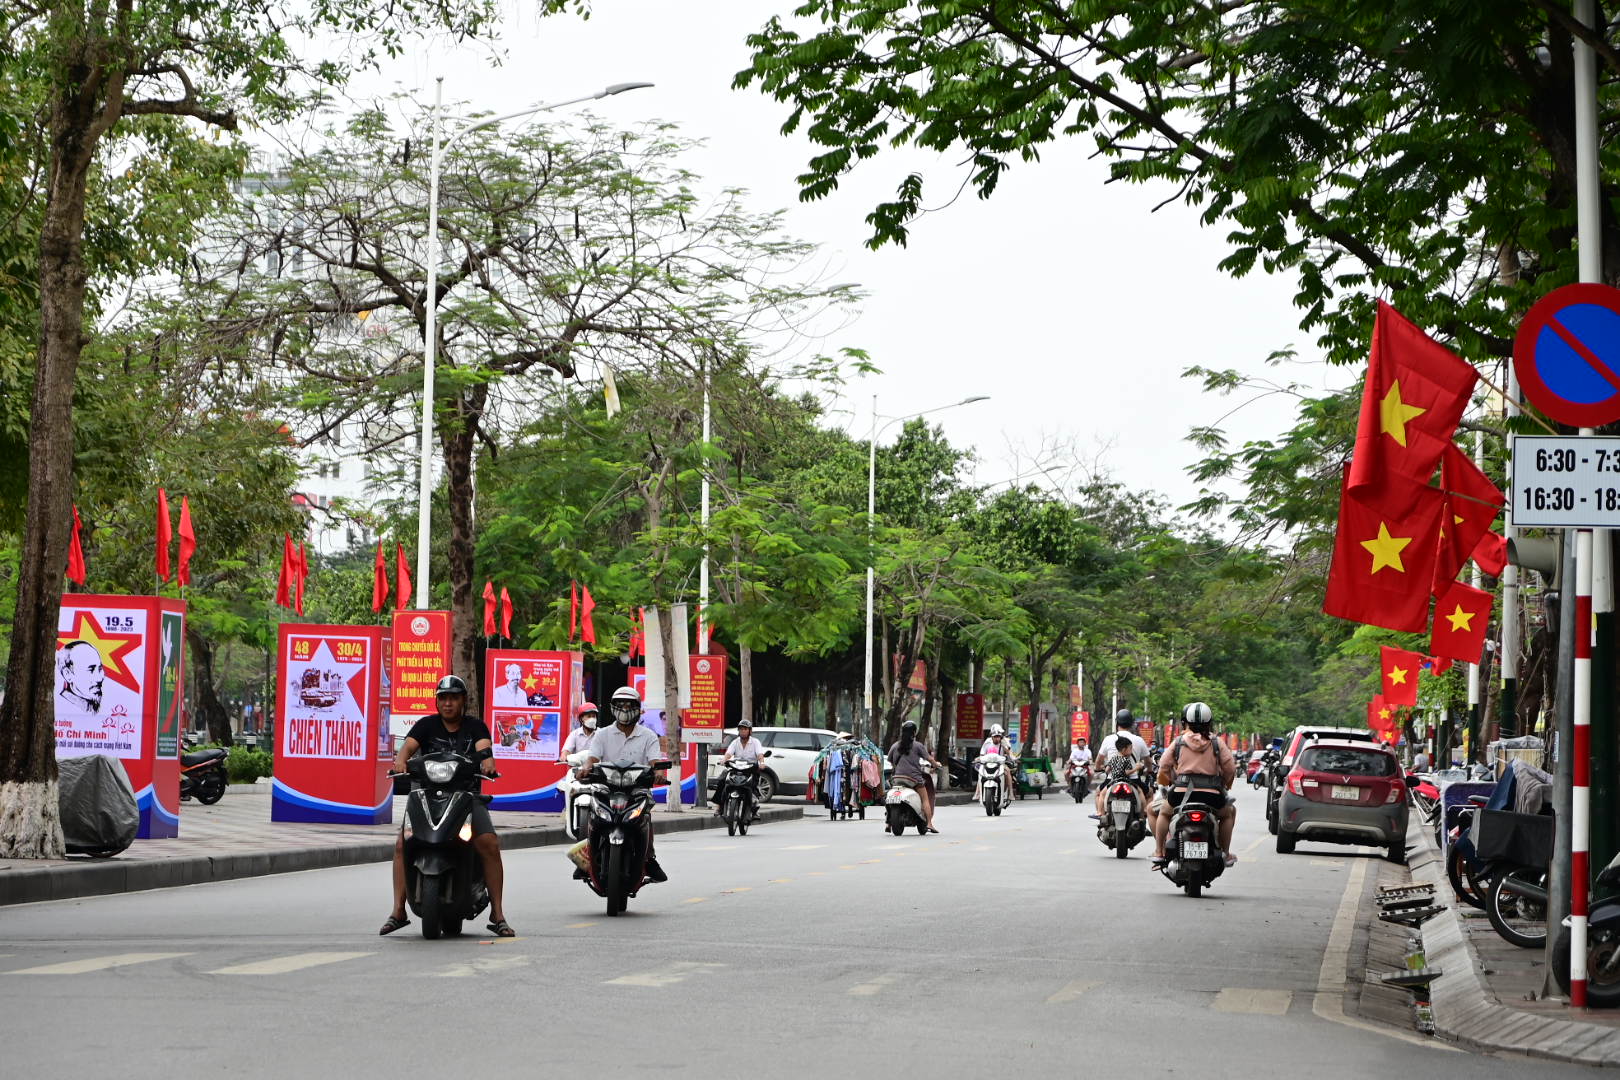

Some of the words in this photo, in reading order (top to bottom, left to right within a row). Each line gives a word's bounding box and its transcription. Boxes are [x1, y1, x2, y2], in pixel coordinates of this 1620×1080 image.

[1536, 448, 1576, 472] 6:30
[1523, 487, 1575, 511] 16:30
[105, 616, 133, 627] 19.5
[294, 640, 309, 655] 48
[336, 642, 362, 656] 30/4
[66, 730, 81, 738] Chí
[84, 730, 107, 739] Minh
[289, 713, 322, 755] CHIẾN
[325, 714, 361, 757] THẮNG
